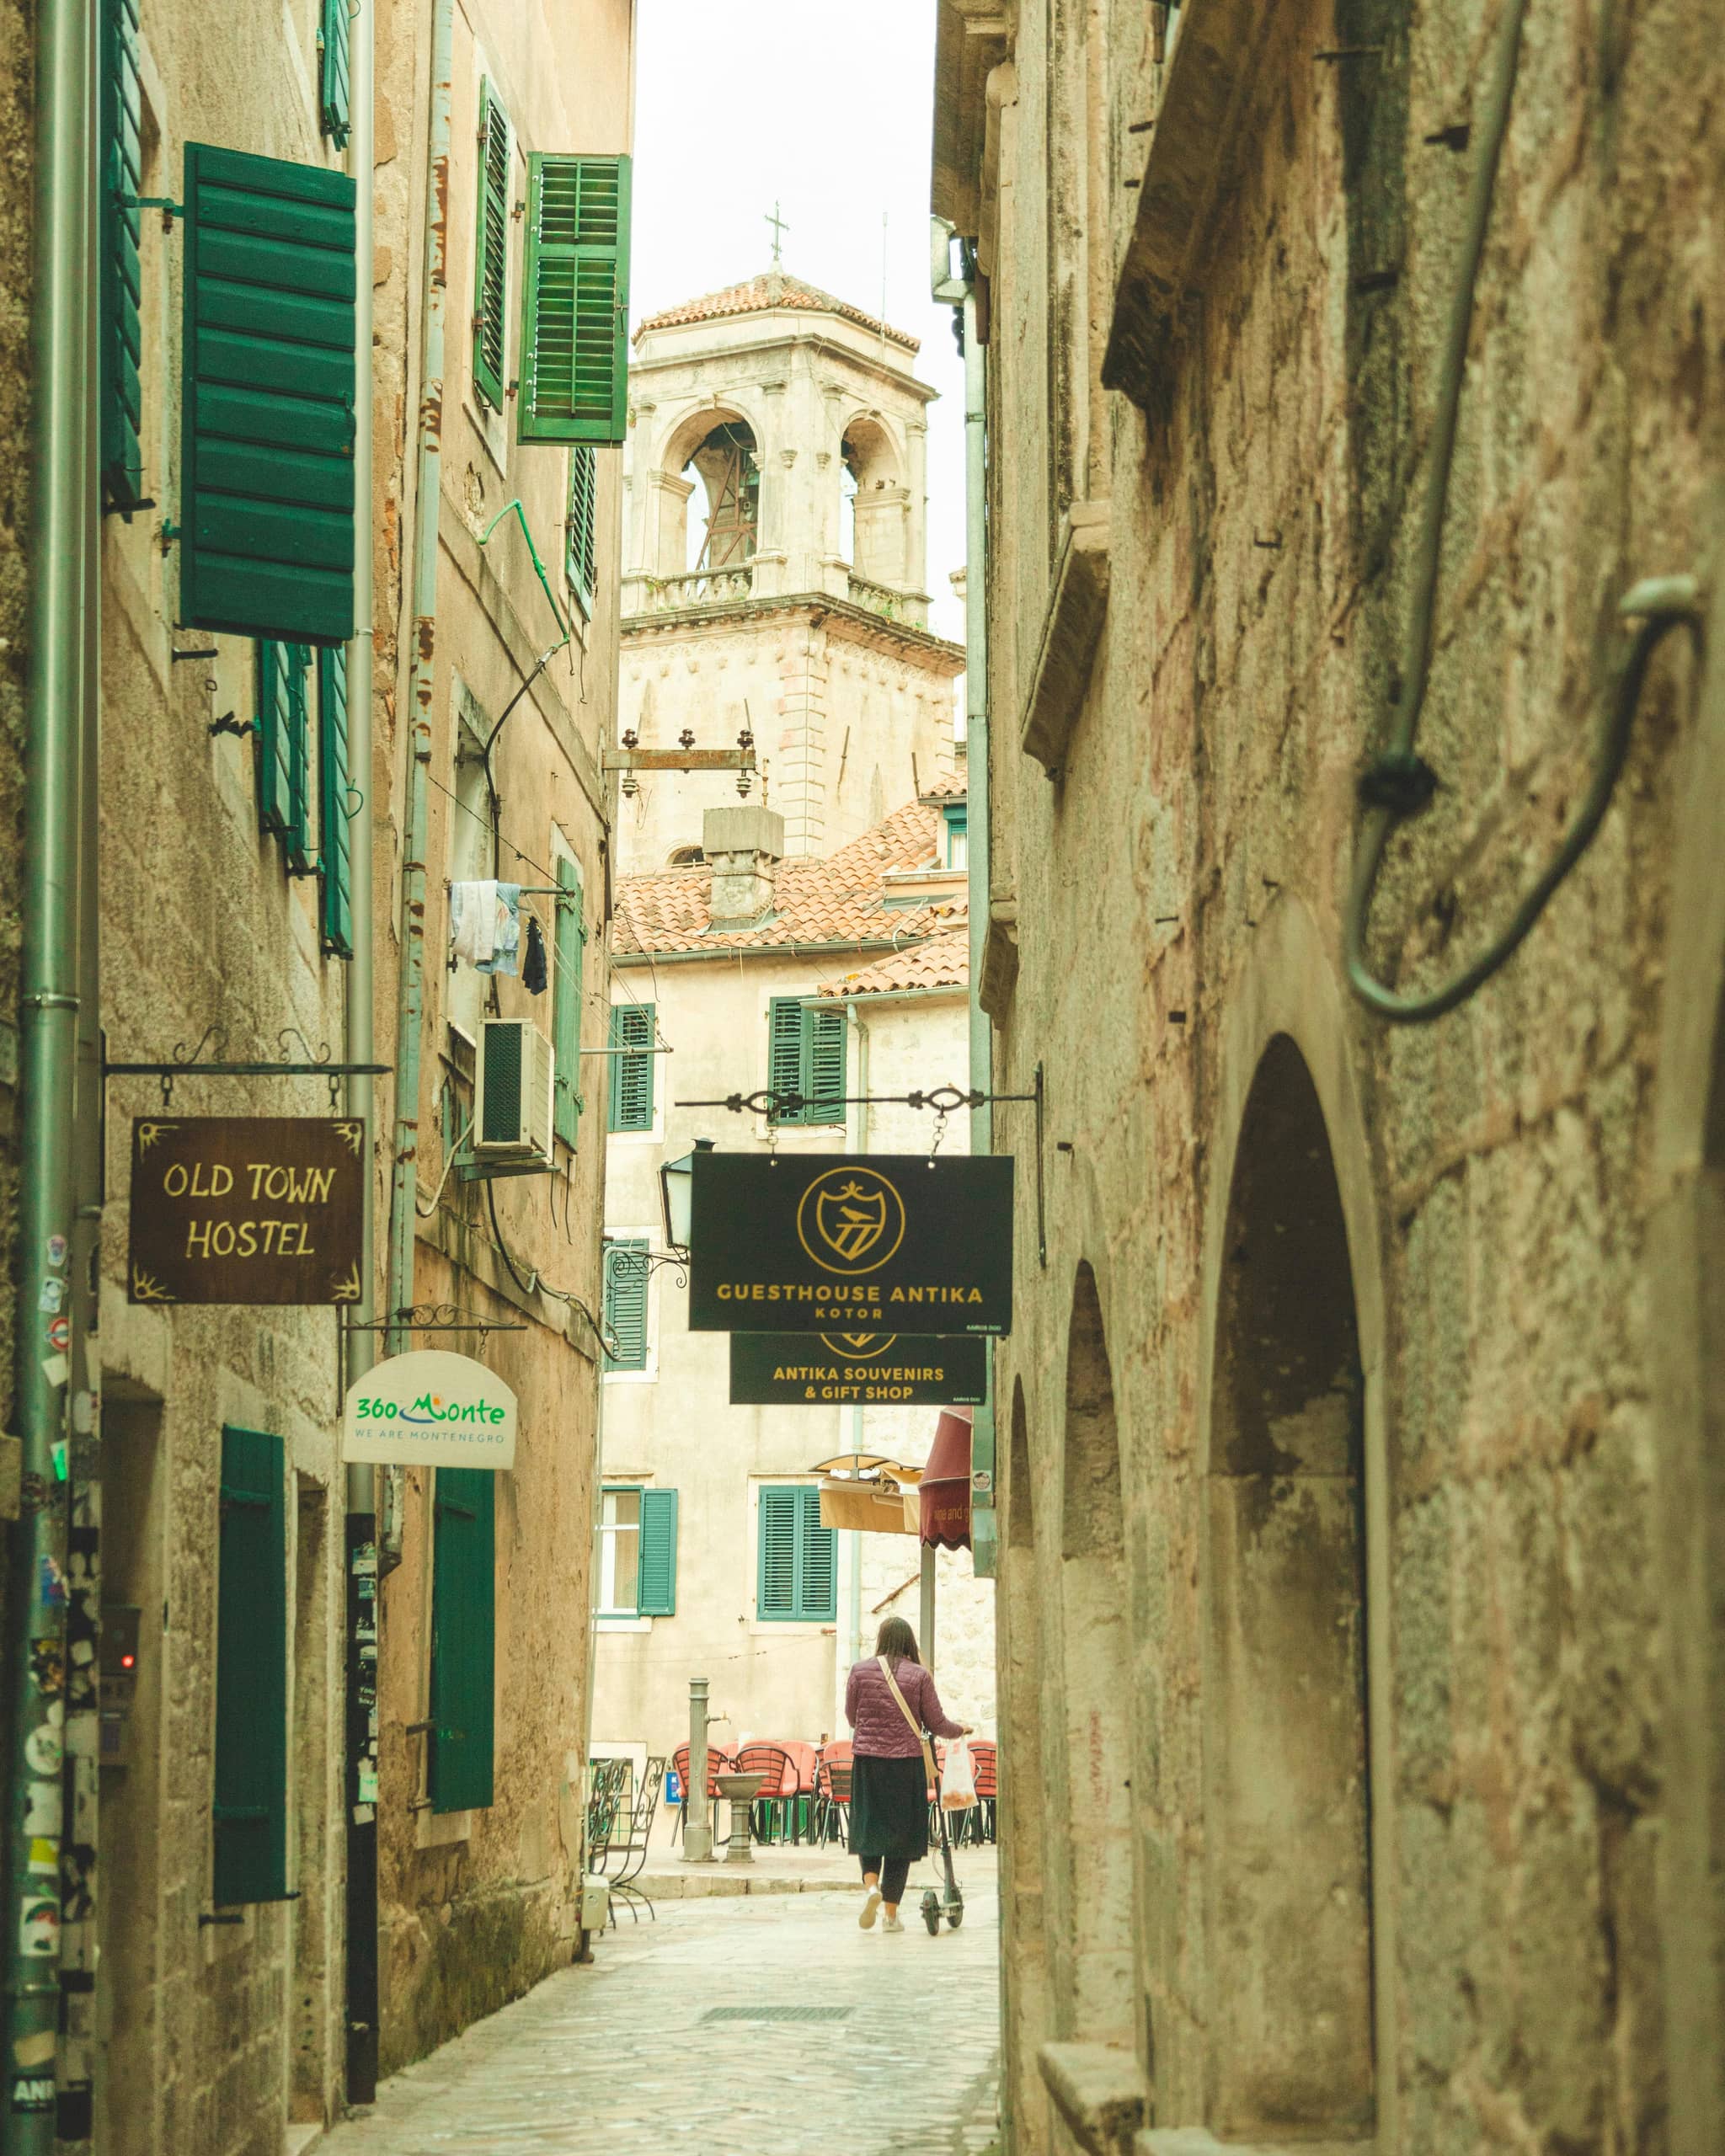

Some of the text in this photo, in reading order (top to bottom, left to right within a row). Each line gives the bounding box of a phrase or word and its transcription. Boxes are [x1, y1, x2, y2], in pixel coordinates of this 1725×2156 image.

[163, 1162, 338, 1204] OLD TOWN
[185, 1219, 316, 1259] HOSTEL
[716, 1283, 984, 1304] GUESTHOUSE ANTIKA
[814, 1307, 884, 1320] KOTOR
[773, 1367, 945, 1382] ANTIKA SOUVENIRS
[804, 1385, 914, 1401] & GIFT SHOP
[355, 1428, 505, 1444] WE ARE MONTENEGRO
[948, 1504, 963, 1521] and
